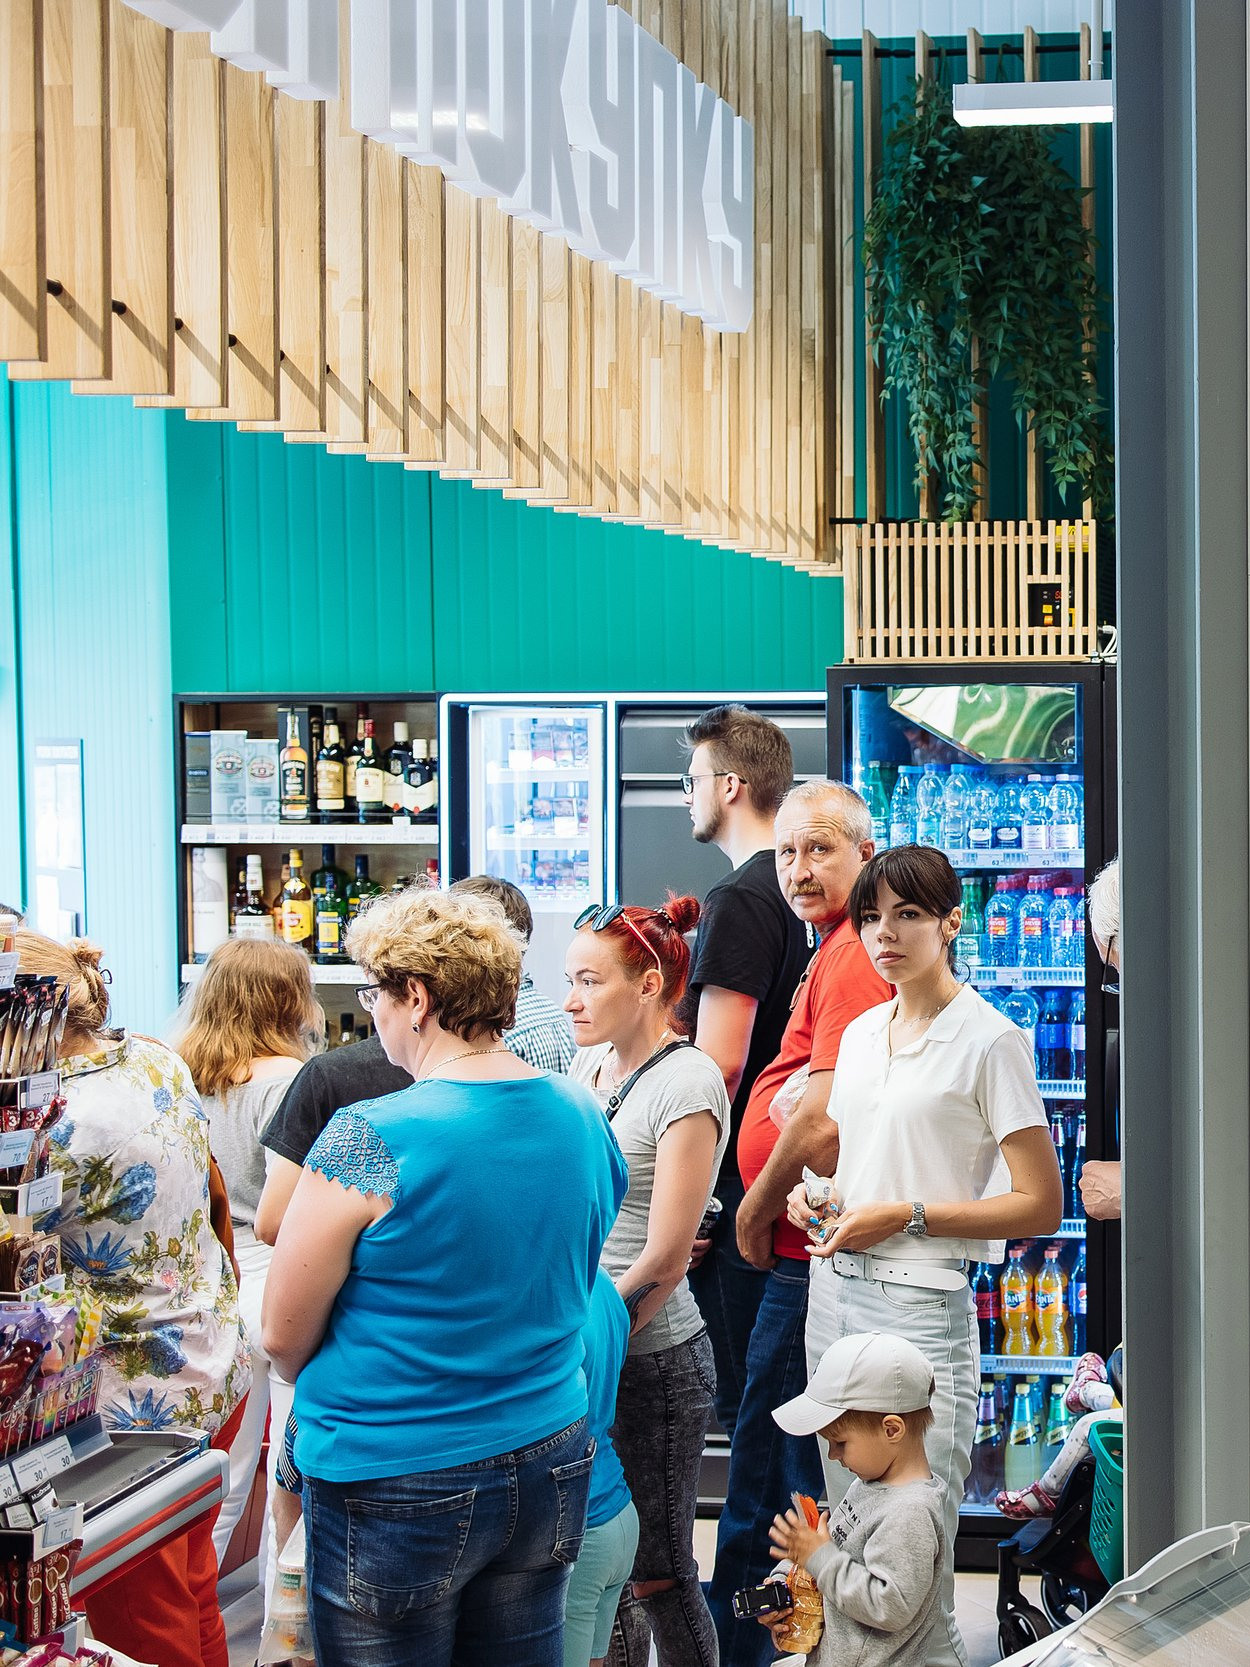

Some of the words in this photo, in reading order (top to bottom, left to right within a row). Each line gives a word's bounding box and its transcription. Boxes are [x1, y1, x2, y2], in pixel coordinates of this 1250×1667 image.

[43, 1093, 50, 1103] 27
[41, 1196, 49, 1207] 17
[61, 1455, 70, 1467] 30
[33, 1469, 43, 1482] 30
[3, 1486, 12, 1499] 30
[61, 1529, 68, 1540] 17
